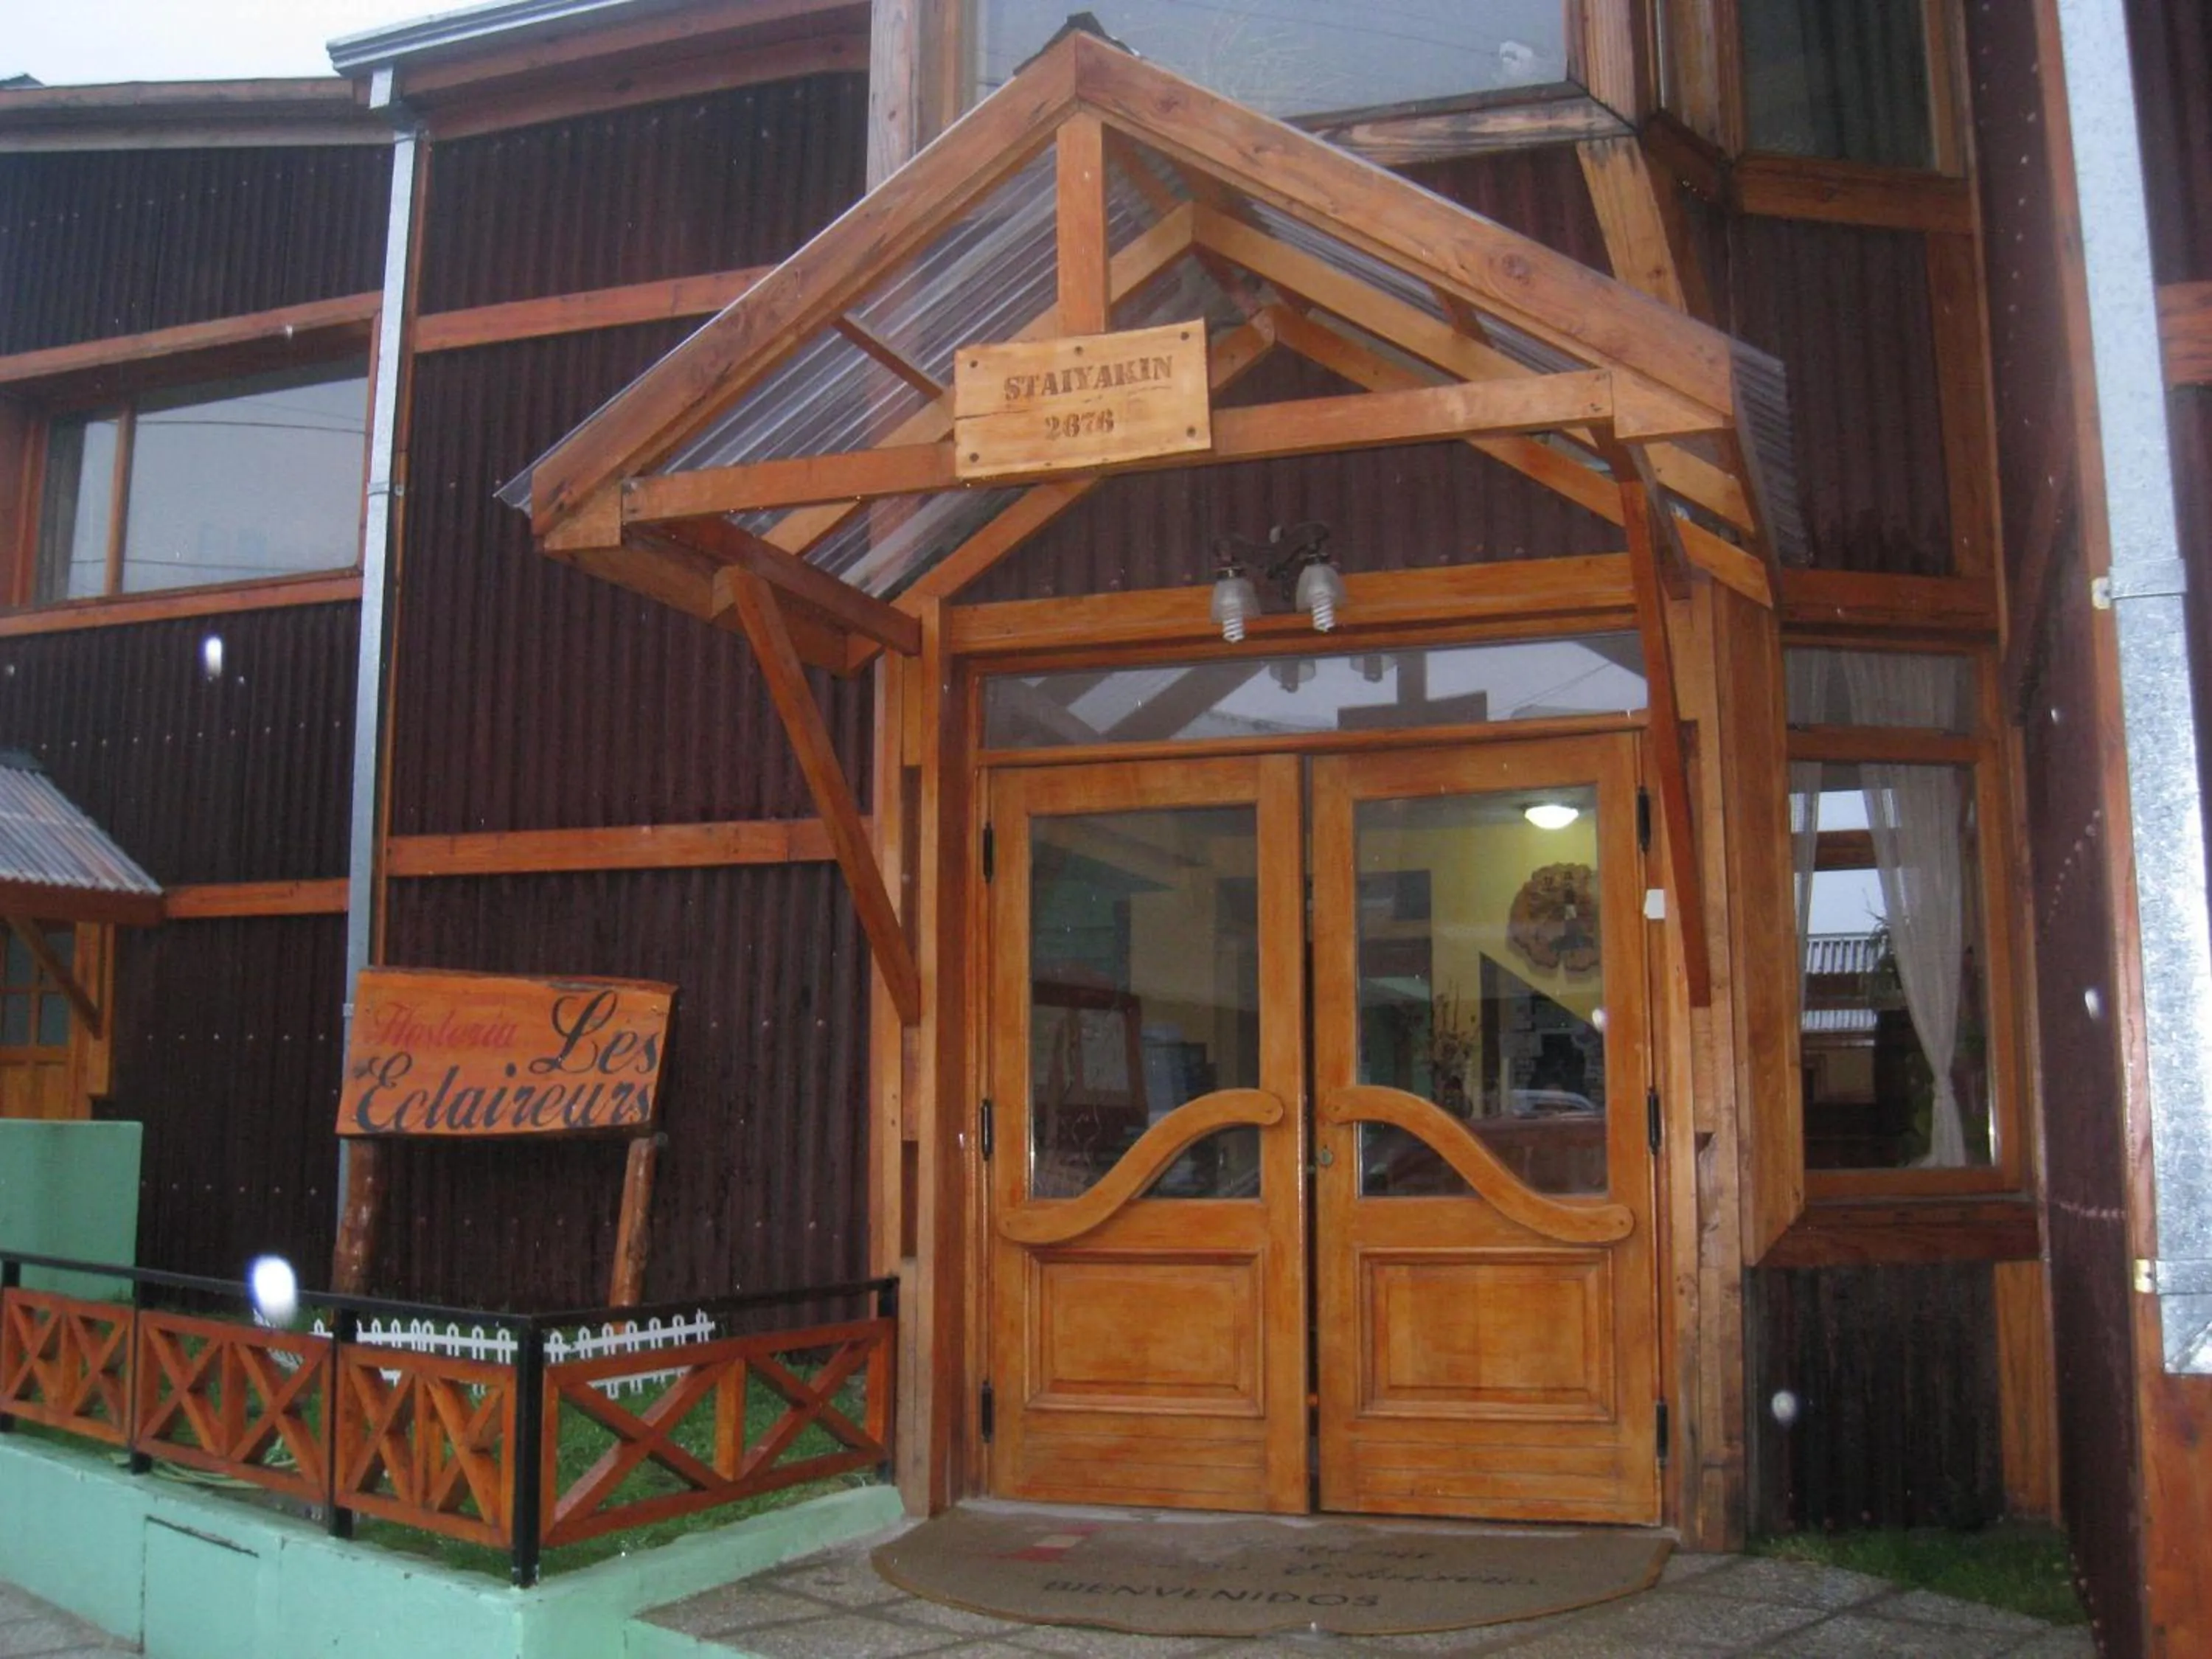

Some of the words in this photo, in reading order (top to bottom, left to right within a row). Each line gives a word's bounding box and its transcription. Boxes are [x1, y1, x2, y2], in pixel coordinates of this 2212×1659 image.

[1004, 355, 1172, 402] STAIYAKIN
[1044, 408, 1115, 440] 2676
[529, 990, 659, 1074] Les
[354, 1051, 653, 1134] Eclaireurs
[1043, 1579, 1379, 1608] BIENVENIDOS
